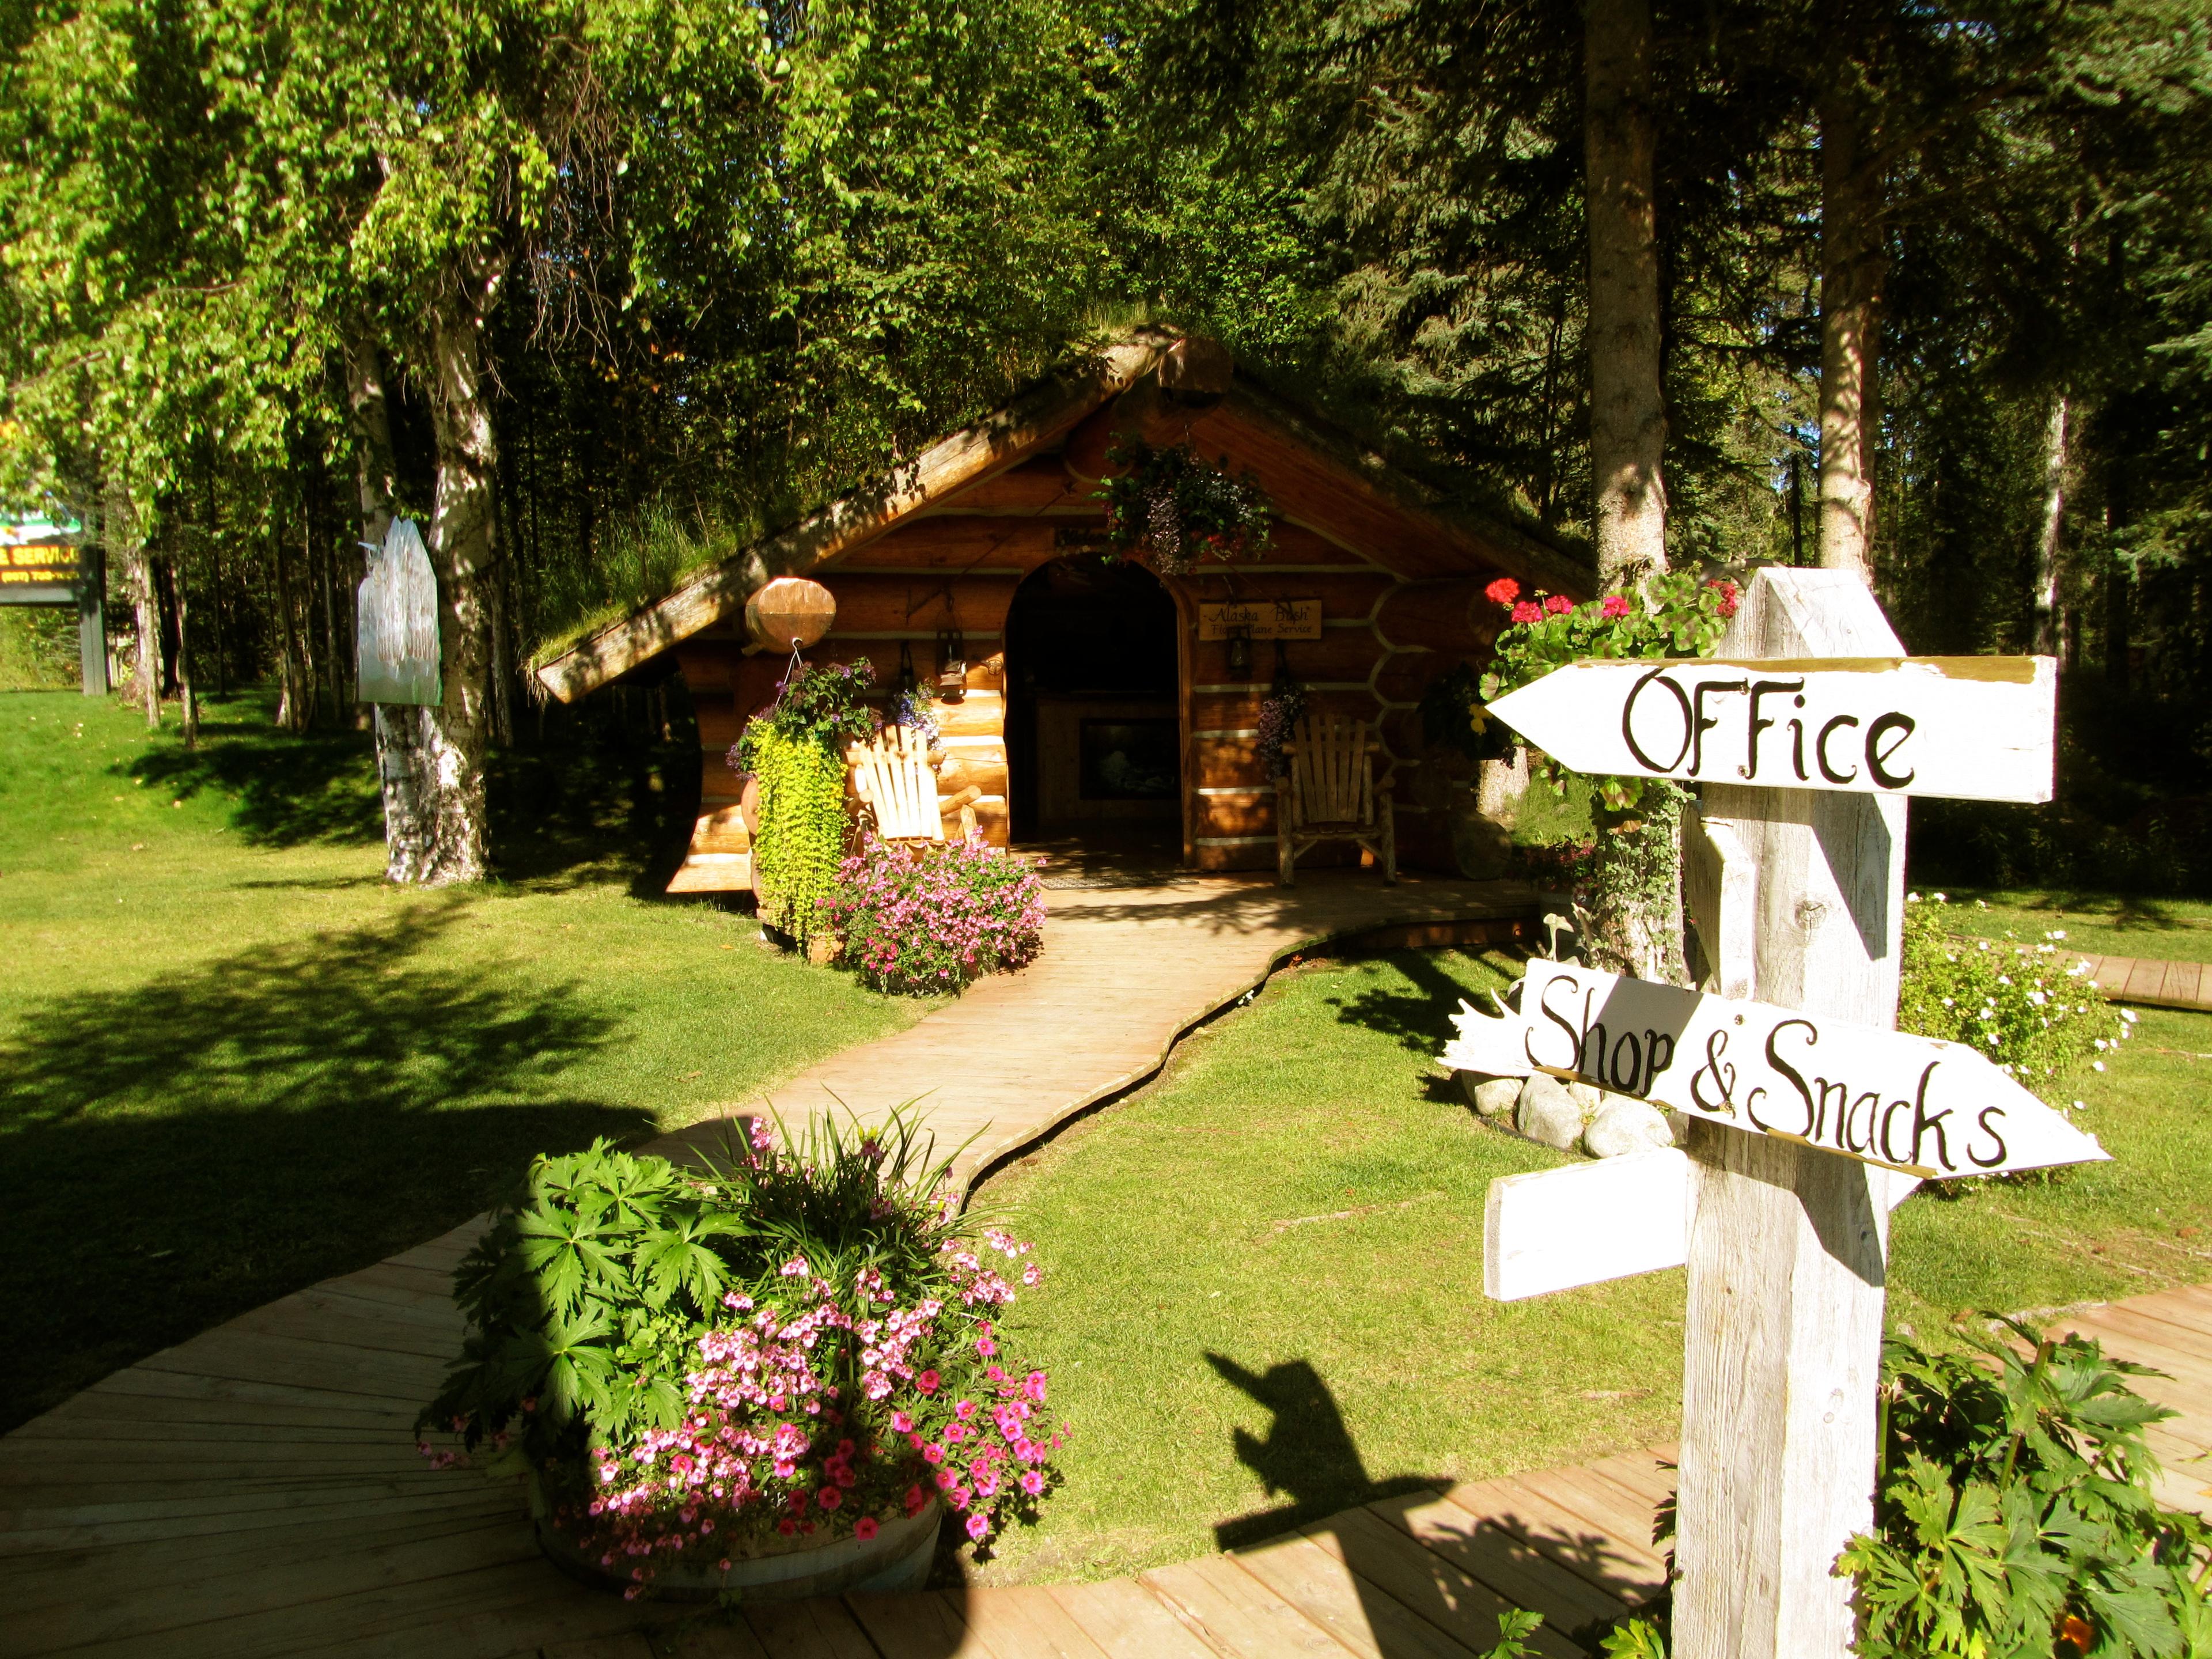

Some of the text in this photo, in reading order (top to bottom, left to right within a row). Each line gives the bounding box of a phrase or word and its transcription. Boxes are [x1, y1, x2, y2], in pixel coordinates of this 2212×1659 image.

[1209, 607, 1309, 622] Alaska Bush
[1277, 623, 1312, 634] Service
[1524, 975, 2008, 1172] Shop & Snacks
